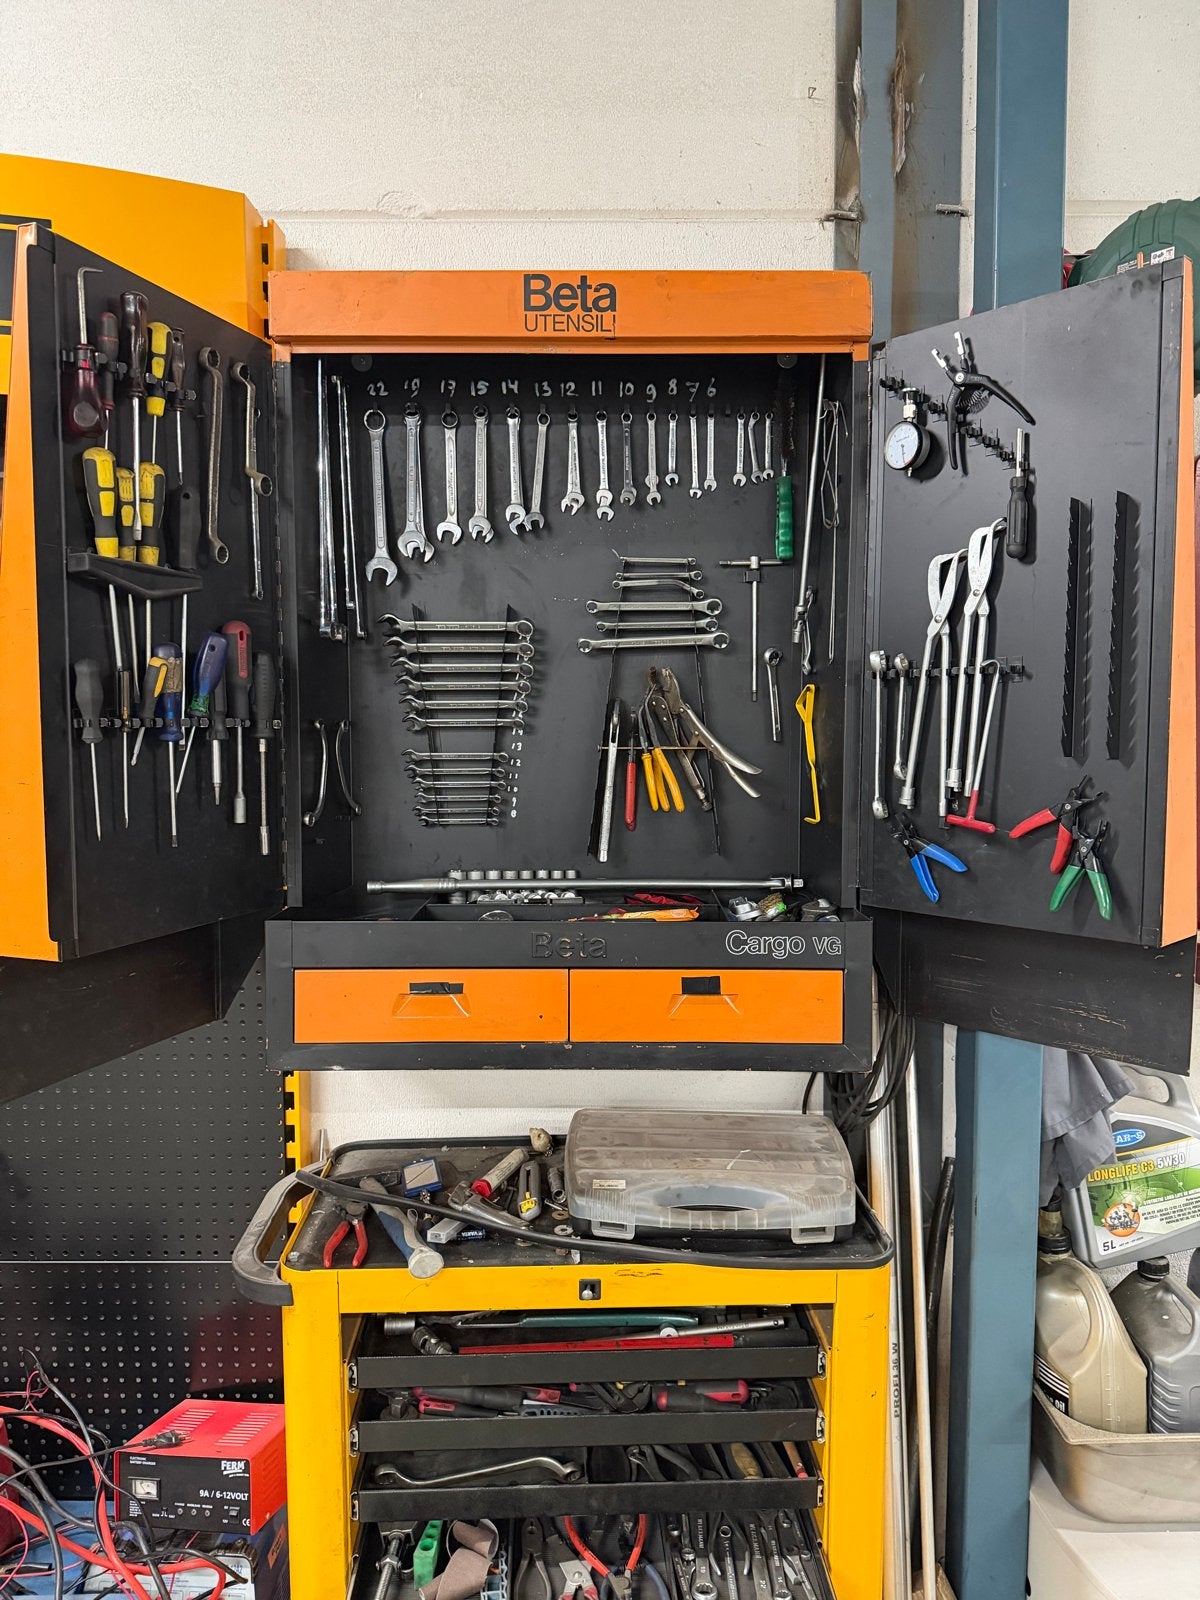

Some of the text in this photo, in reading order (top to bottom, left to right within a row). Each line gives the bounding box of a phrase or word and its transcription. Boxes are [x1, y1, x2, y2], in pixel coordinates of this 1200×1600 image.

[523, 273, 617, 313] Beta
[525, 313, 616, 332] UTENSILI
[367, 376, 717, 402] 22 19 17 15 14 13 12 11 10 9 8 7 6
[511, 742, 522, 751] 13
[510, 758, 522, 767] 12
[509, 772, 518, 780] 11
[507, 785, 518, 793] 10
[510, 809, 517, 818] 8
[531, 930, 608, 960] Beta
[725, 929, 842, 960] Cargo VG
[1087, 1152, 1186, 1182] LONGLIFE C3 5W30
[1102, 1238, 1117, 1253] 5L
[891, 1342, 900, 1418] PROFI 36 W
[221, 1460, 245, 1471] FERM
[199, 1489, 209, 1498] 9A
[216, 1490, 249, 1501] 6-12VOLT
